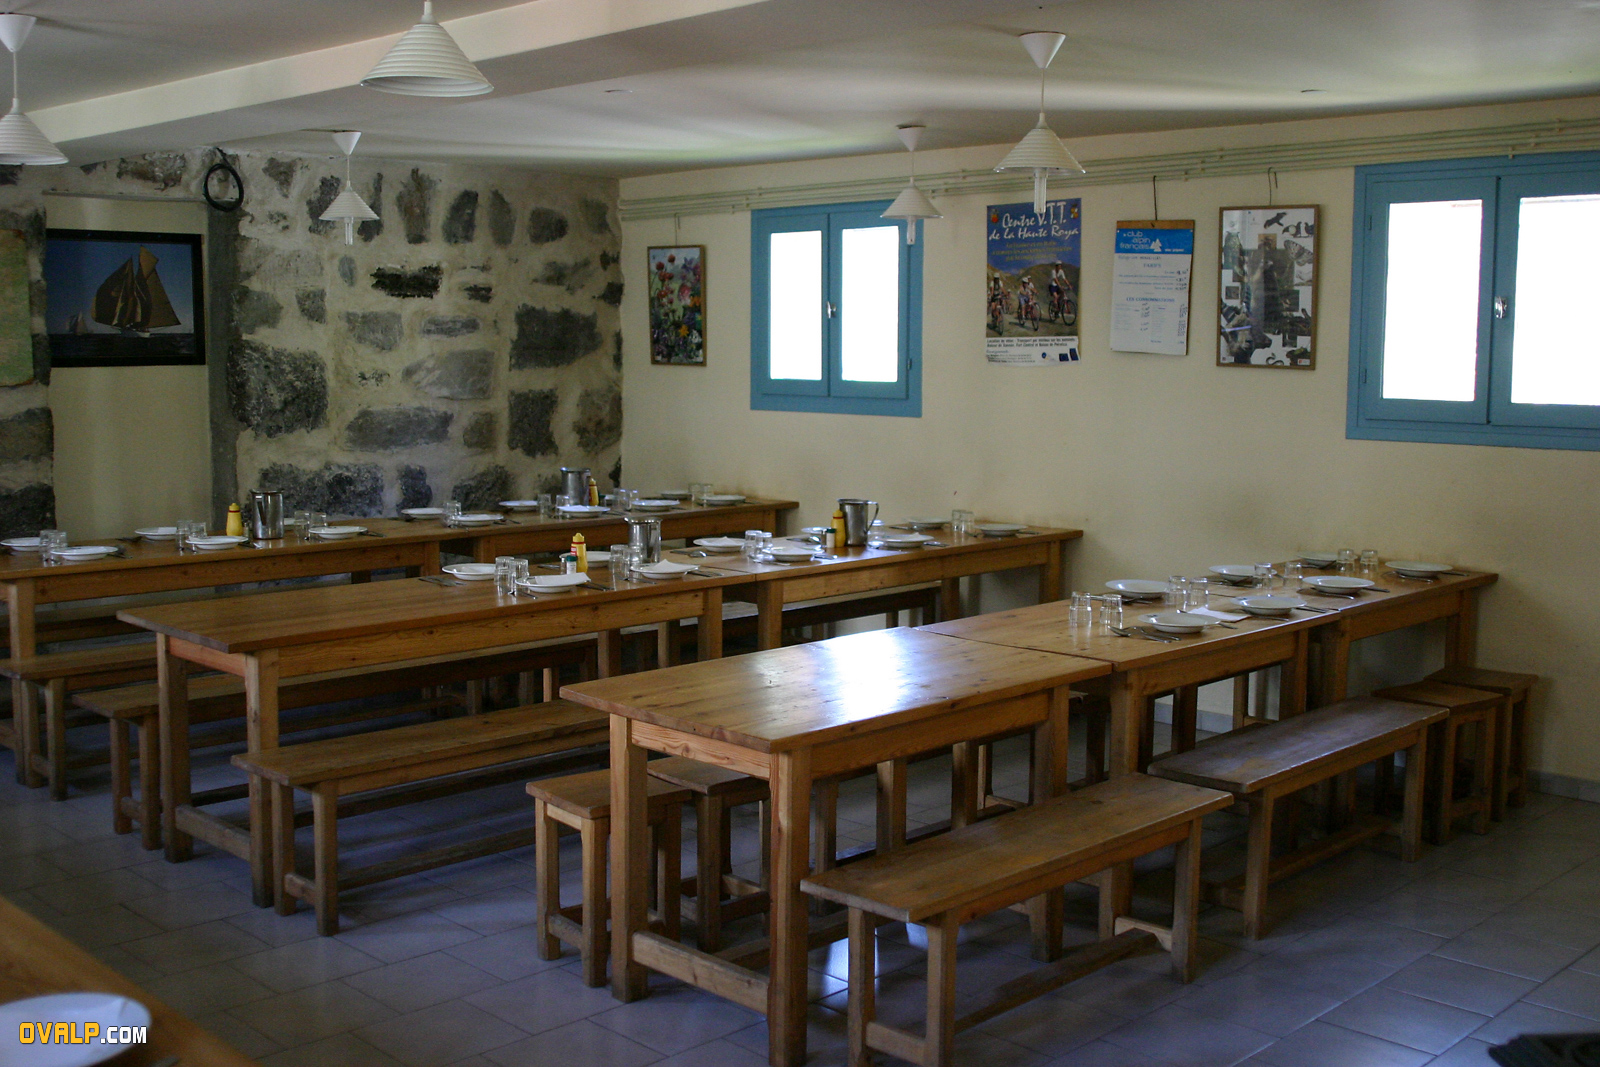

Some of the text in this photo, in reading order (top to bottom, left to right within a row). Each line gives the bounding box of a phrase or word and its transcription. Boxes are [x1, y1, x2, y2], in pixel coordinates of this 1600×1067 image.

[1002, 213, 1035, 228] Centre
[989, 225, 1079, 240] de la Haute Roya
[1120, 242, 1150, 250] français
